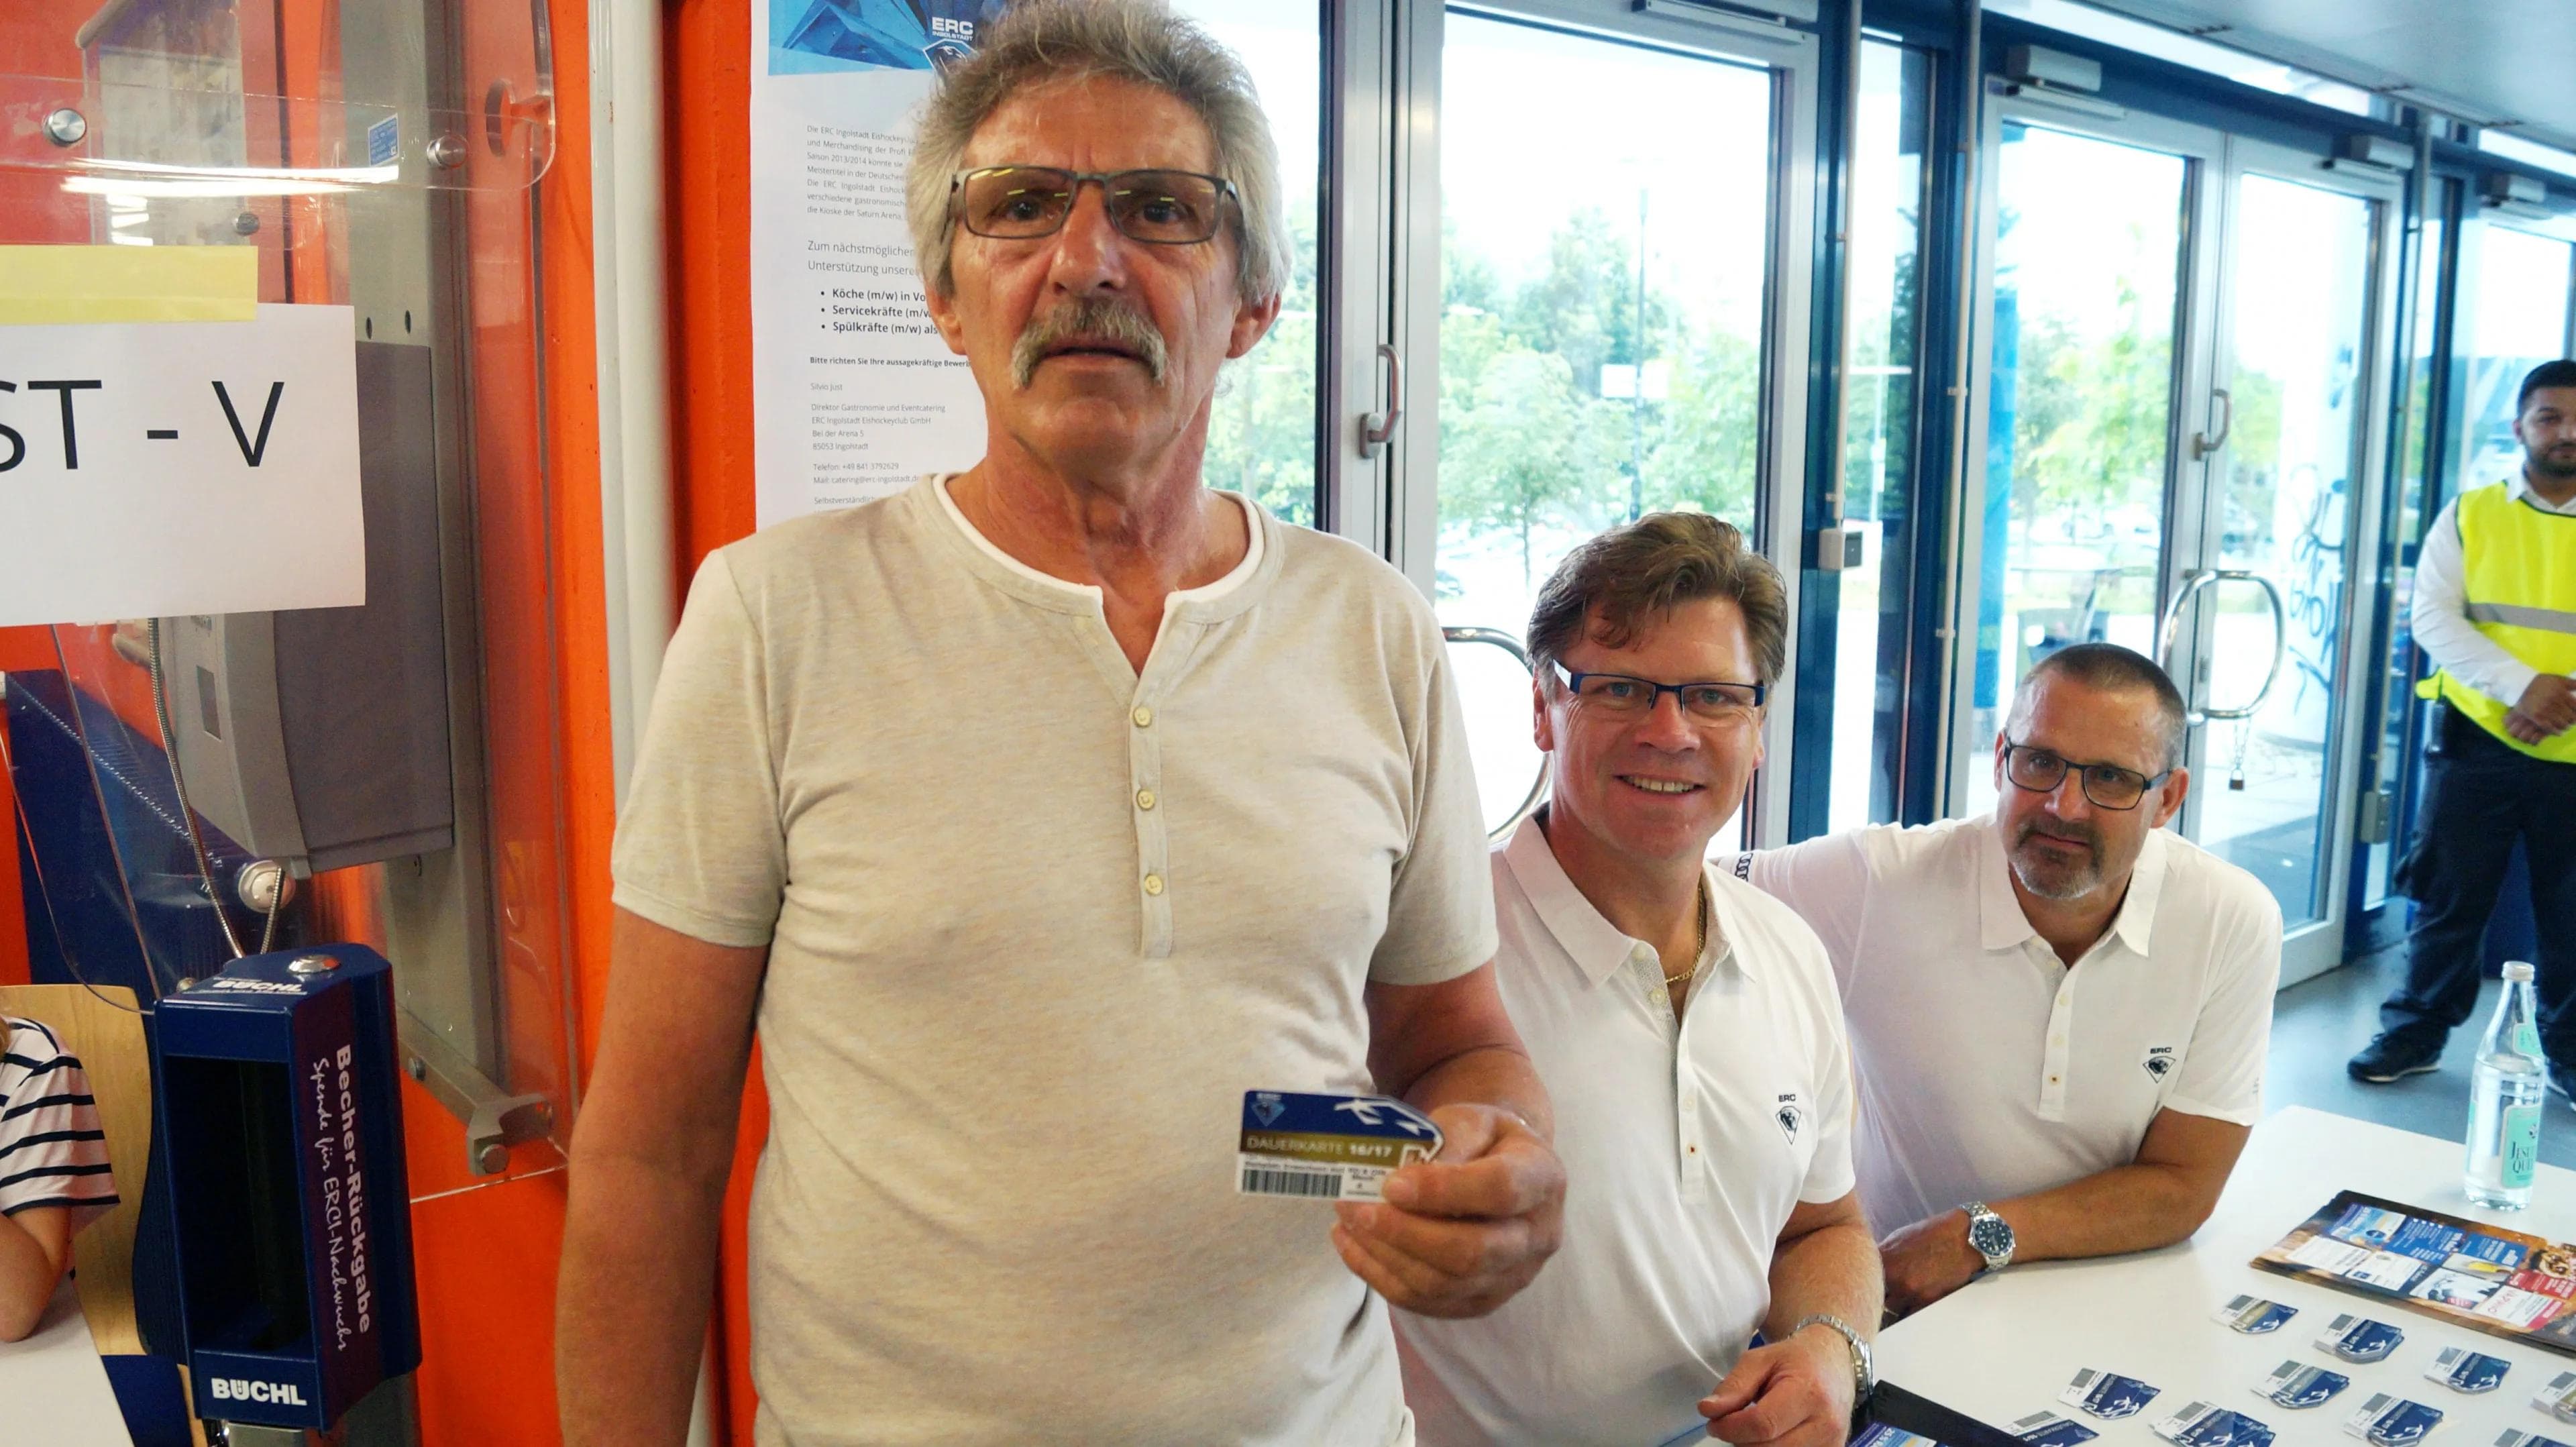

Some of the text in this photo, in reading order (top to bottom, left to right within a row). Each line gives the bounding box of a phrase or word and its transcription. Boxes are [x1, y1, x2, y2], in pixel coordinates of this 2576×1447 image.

[932, 17, 973, 35] ERC
[932, 30, 973, 41] INGOLSTADT
[807, 125, 818, 133] Die
[820, 126, 834, 134] ERC
[836, 128, 869, 138] Ingolstadt
[823, 141, 873, 154] Merchandising
[875, 146, 886, 154] der
[889, 147, 906, 156] Profi
[807, 152, 829, 162] Saison
[831, 155, 867, 165] 2013/2014
[868, 158, 892, 168] konnte
[807, 166, 845, 177] Meistertitel
[855, 170, 867, 178] der
[807, 178, 818, 186] Die
[824, 180, 837, 189] ERC
[841, 182, 875, 192] Ingolstadt
[807, 193, 852, 203] verschiedene
[820, 207, 842, 215] Kioske
[857, 209, 879, 218] Saturn
[808, 240, 830, 252] Zum
[808, 260, 879, 276] Unterstützung
[833, 288, 864, 299] Köche
[867, 290, 898, 302] (m/w)
[900, 291, 910, 301] in
[833, 305, 902, 317] Servicekräfte
[833, 321, 938, 335] Spülkräfte (m/w) als
[886, 359, 942, 368] aussagekräftige
[830, 384, 843, 392] Just
[841, 404, 885, 412] Gastronomie
[887, 404, 900, 412] und
[901, 405, 946, 413] Eventcatering
[211, 381, 284, 467] V
[827, 417, 860, 426] Ingolstadt
[862, 417, 908, 427] Eishockeyclub
[835, 443, 869, 452] Ingolstadt
[2150, 1047, 2172, 1055] ERC
[310, 1057, 332, 1131] Spende
[1778, 1093, 1796, 1102] ERC
[1246, 1135, 1393, 1157] DAUERKARTE 16/17
[314, 1137, 335, 1171] für
[337, 1044, 371, 1334] Becher-Rückgabe
[211, 1377, 309, 1406] BÜCHL
